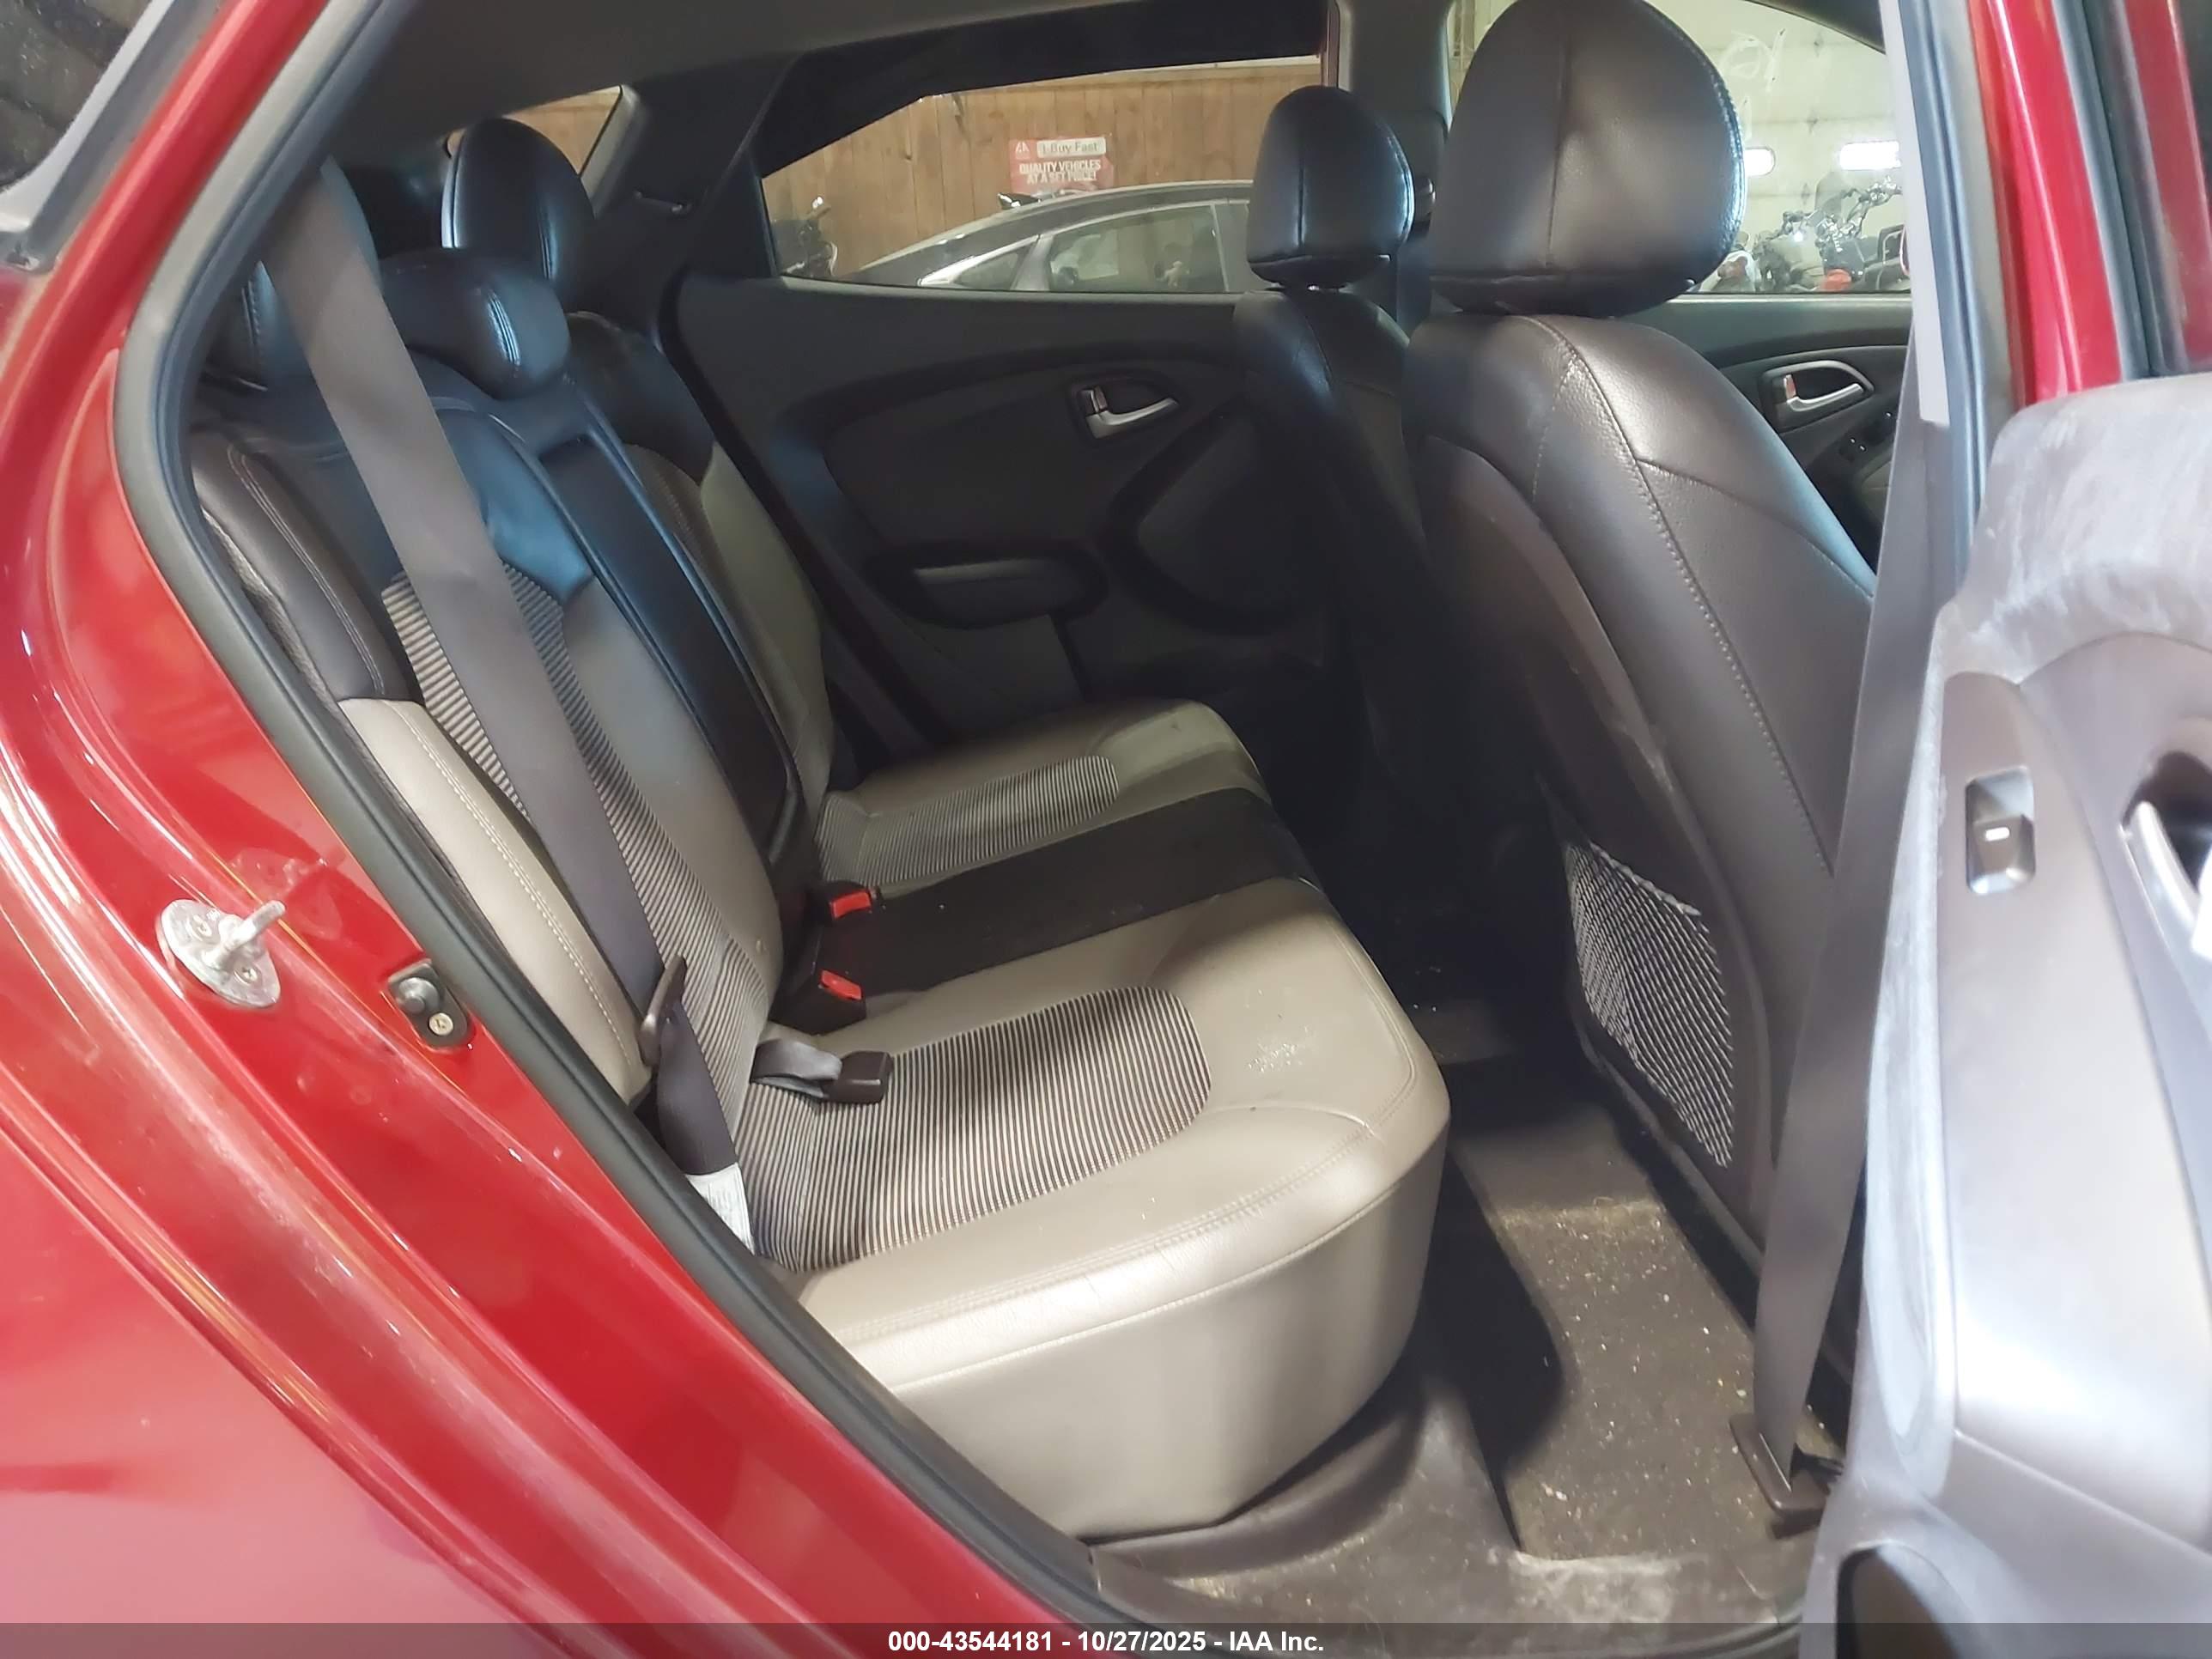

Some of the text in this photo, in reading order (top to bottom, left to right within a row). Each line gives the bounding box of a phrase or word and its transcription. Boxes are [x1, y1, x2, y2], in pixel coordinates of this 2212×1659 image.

[1074, 141, 1098, 153] Fast
[1019, 159, 1101, 175] QUALITY VEHICLES
[1040, 173, 1048, 184] A
